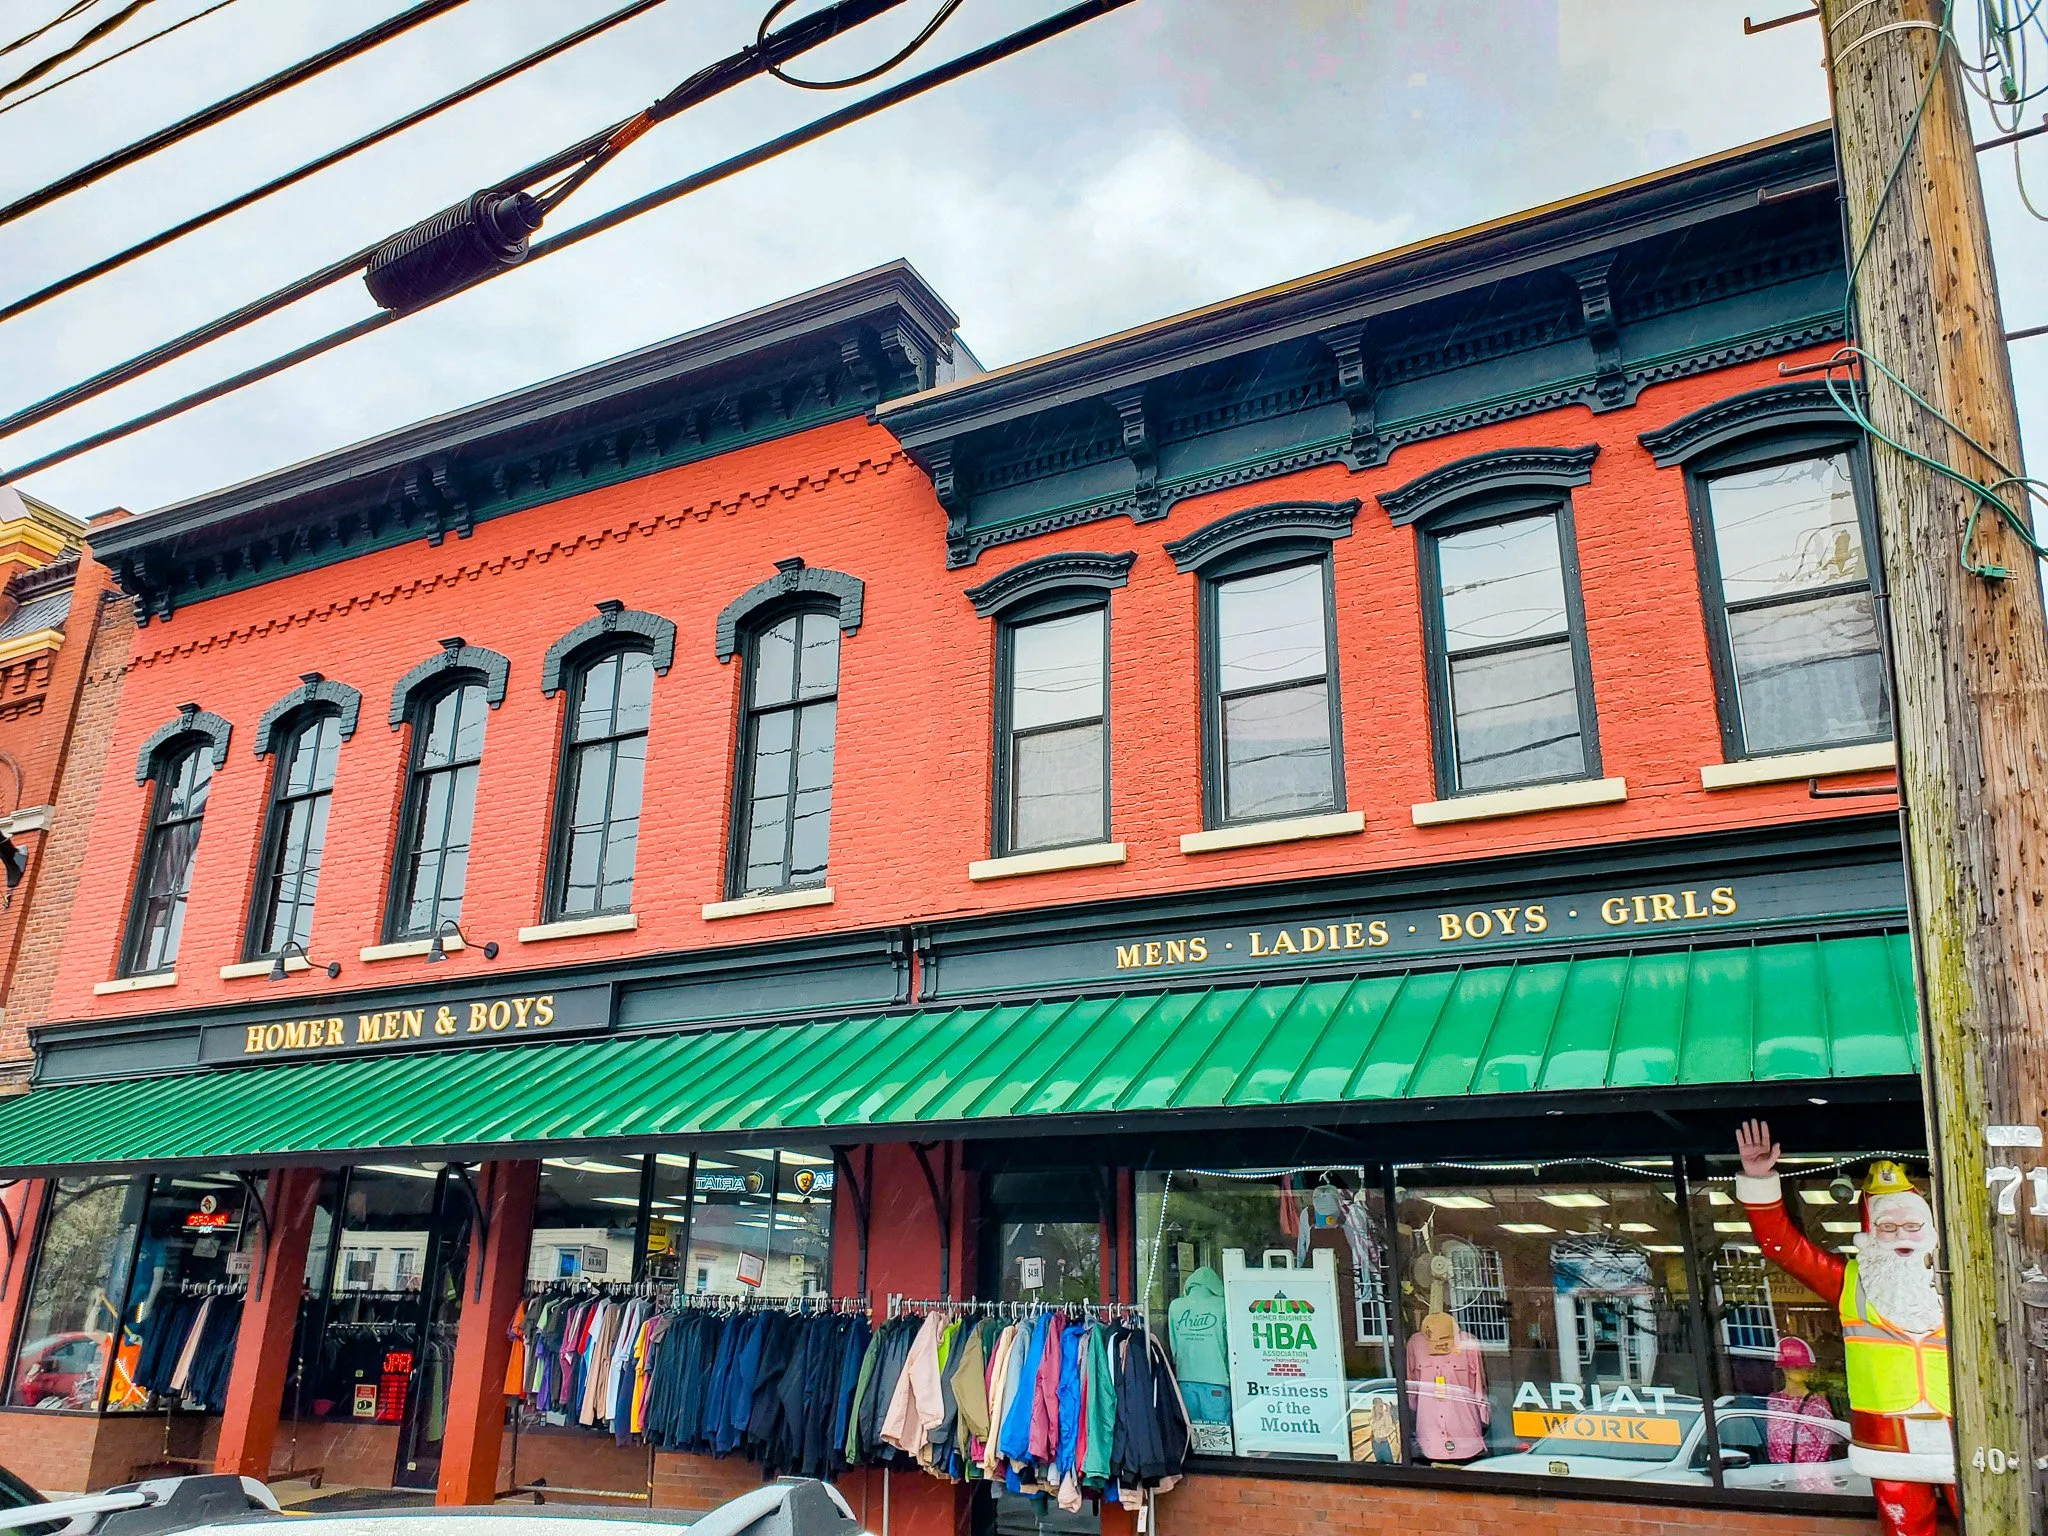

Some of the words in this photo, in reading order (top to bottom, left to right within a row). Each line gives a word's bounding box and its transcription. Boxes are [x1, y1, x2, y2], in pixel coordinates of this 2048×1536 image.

[1115, 937, 1209, 969] MENS
[1249, 920, 1389, 957] LADIES
[1438, 905, 1548, 941] BOYS
[1601, 886, 1738, 926] GIRLS
[244, 1017, 344, 1053] HOMER
[356, 1008, 425, 1043] MEN
[434, 1005, 457, 1035] &
[468, 994, 555, 1032] BOYS
[1253, 1314, 1277, 1322] HOMER
[1252, 1322, 1318, 1350] HBA
[1262, 1350, 1308, 1358] ASSOCIATION
[1246, 1381, 1328, 1398] Business
[1512, 1381, 1676, 1416] ARIAT
[1267, 1400, 1283, 1414] of
[1286, 1401, 1311, 1415] the
[1260, 1417, 1321, 1434] Month
[1543, 1415, 1649, 1441] WORK
